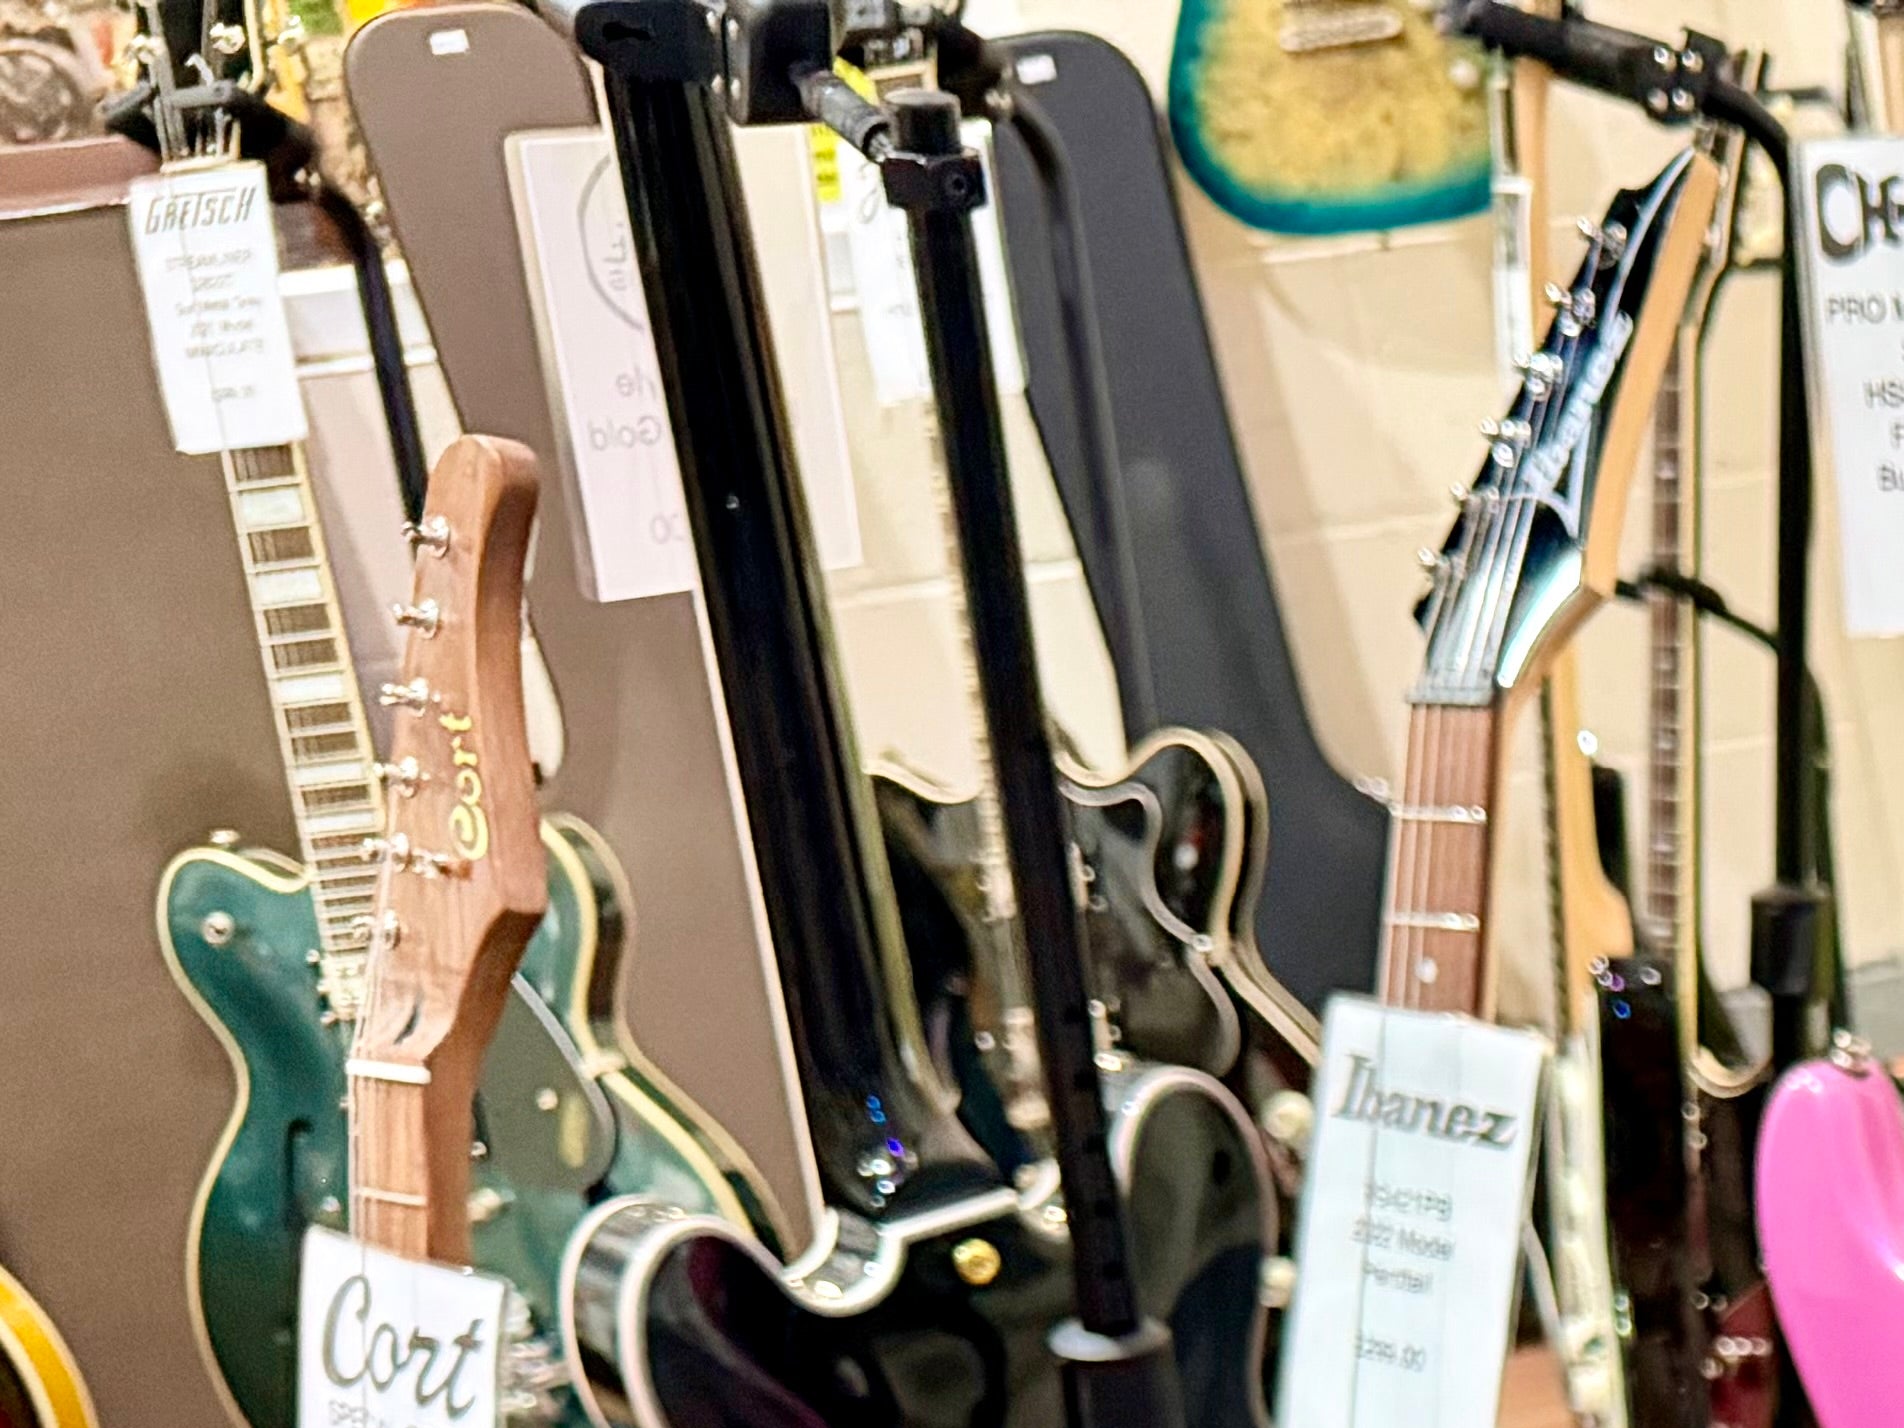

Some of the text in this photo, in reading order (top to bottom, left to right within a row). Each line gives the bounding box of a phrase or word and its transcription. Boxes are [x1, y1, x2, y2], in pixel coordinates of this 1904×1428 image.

[144, 186, 257, 235] GRETSCH
[1827, 294, 1887, 323] PRO
[438, 712, 489, 861] Cort
[1331, 1053, 1519, 1152] Ibanez
[322, 1273, 484, 1421] Cort
